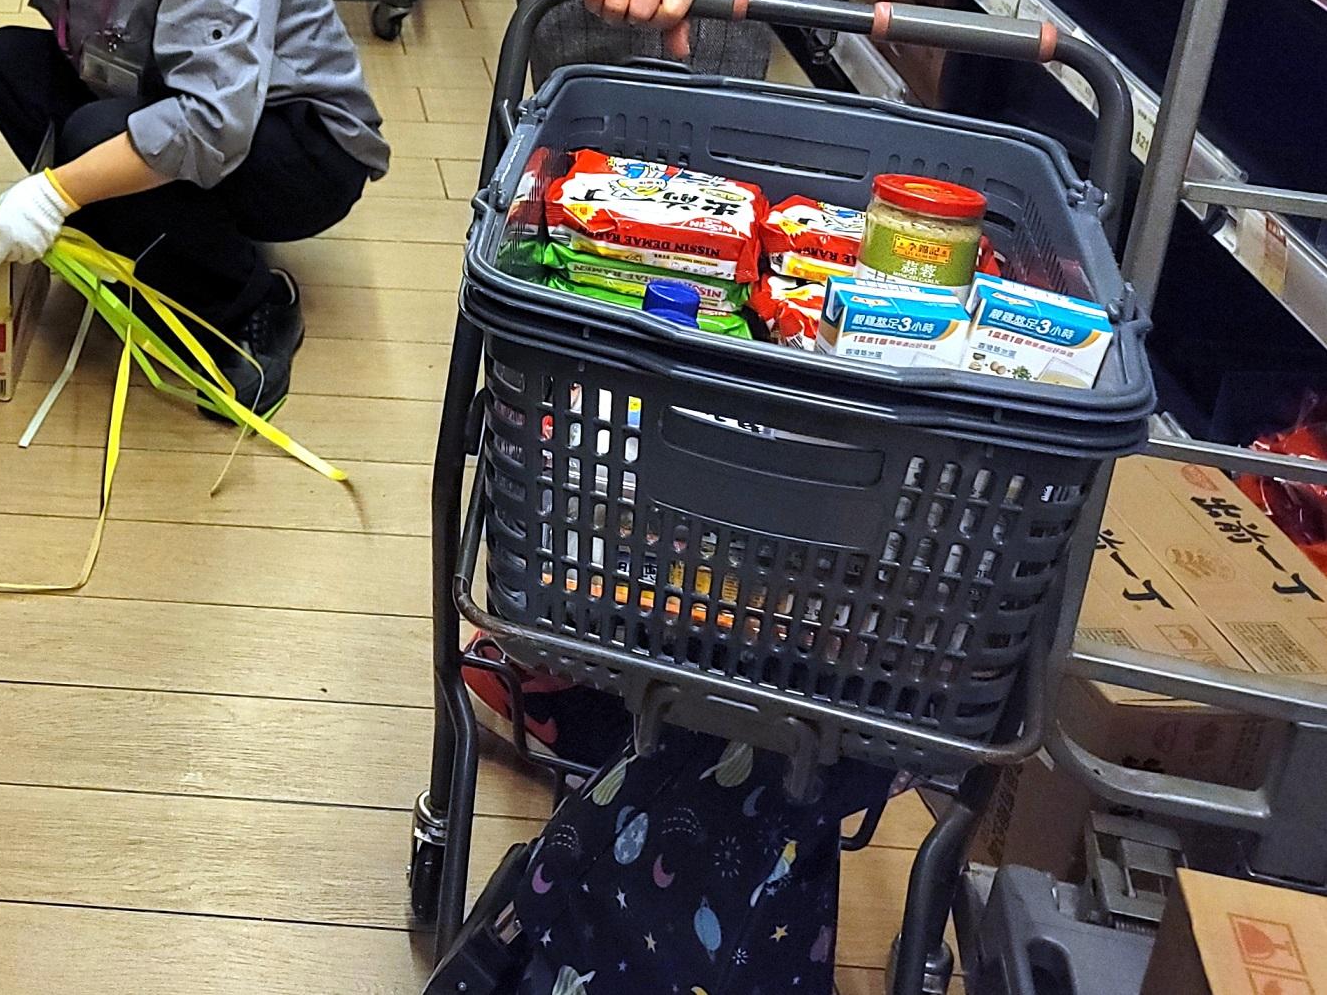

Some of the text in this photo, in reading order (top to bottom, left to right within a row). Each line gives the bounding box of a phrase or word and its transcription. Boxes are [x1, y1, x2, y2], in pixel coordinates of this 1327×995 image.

[688, 218, 734, 234] NISSIN
[625, 236, 671, 251] DEMAE
[674, 242, 721, 257] NISSIN
[1190, 496, 1326, 604] 出前一丁
